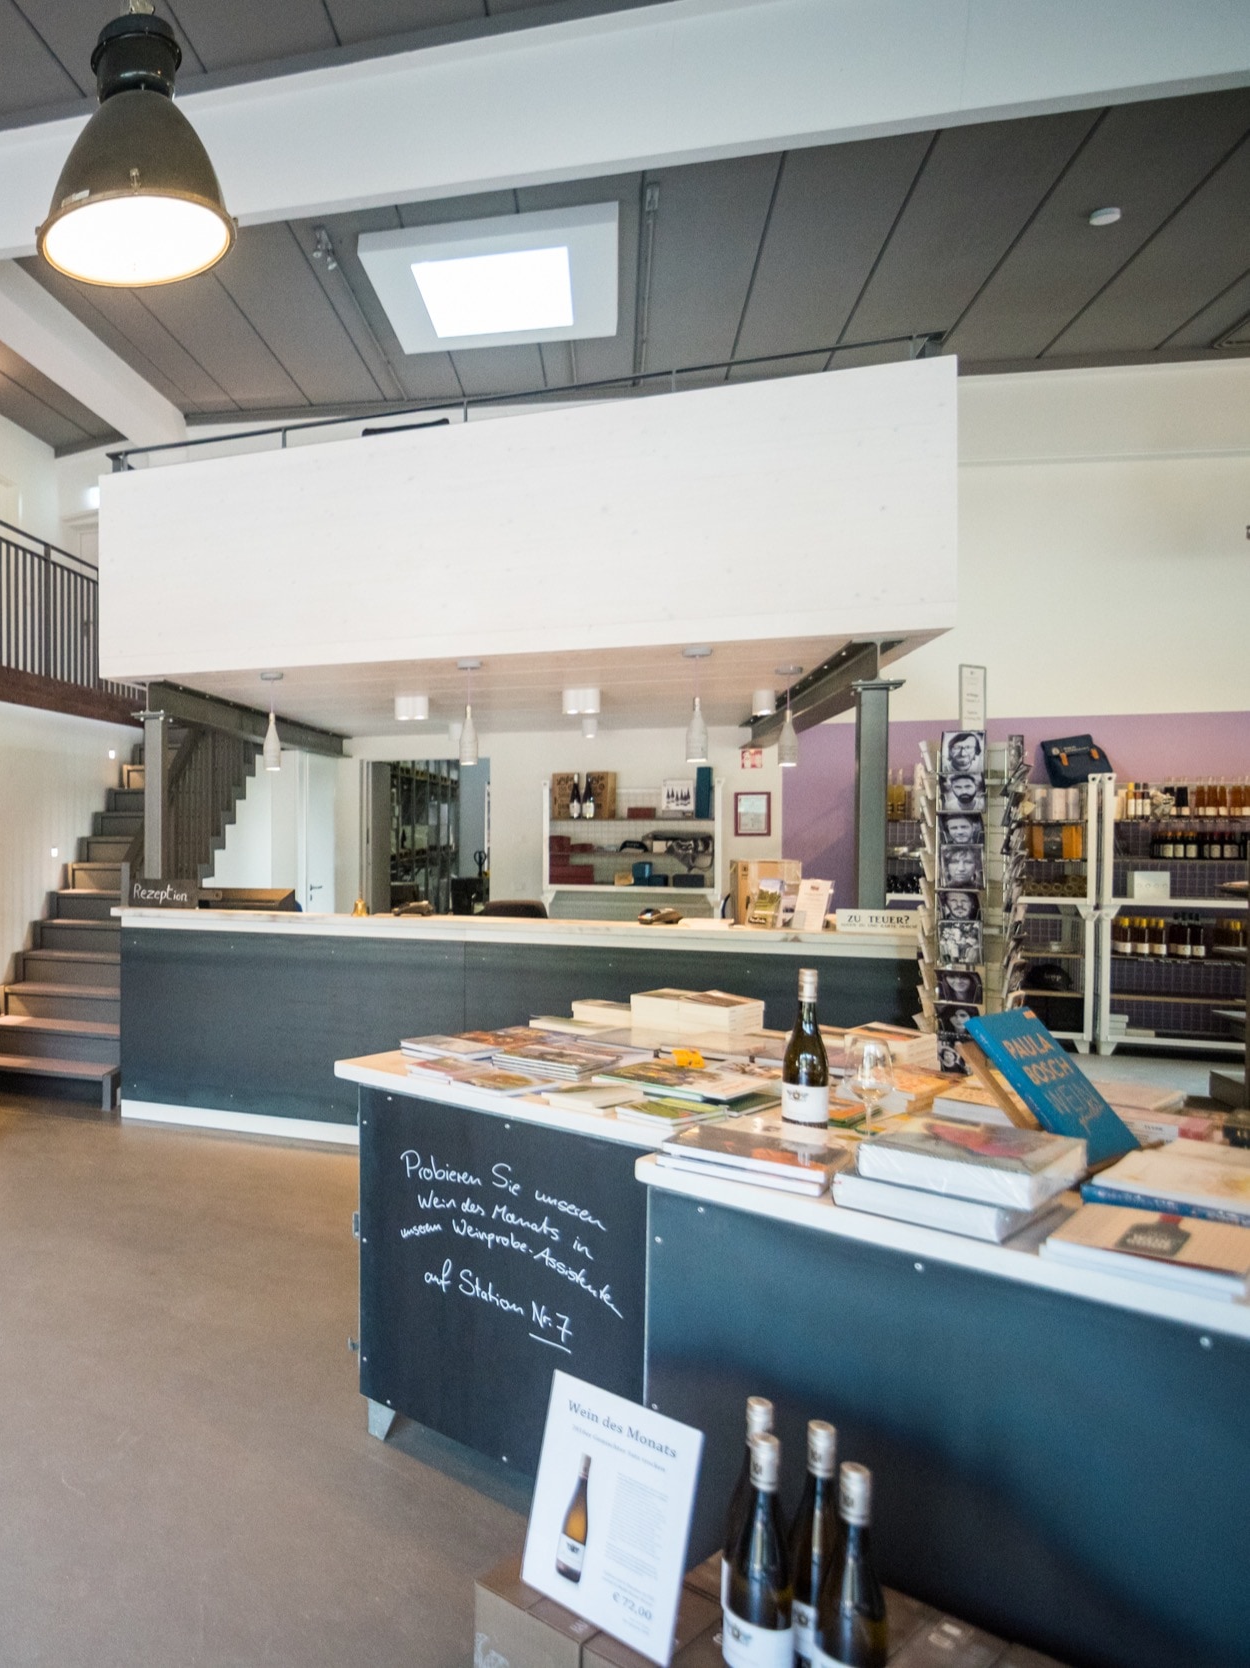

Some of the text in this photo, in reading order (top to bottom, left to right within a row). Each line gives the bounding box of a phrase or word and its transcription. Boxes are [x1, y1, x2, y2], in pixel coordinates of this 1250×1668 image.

[133, 882, 188, 905] Rezeption
[847, 914, 910, 924] ZU TEUER?
[1002, 1032, 1055, 1060] PAULA
[1022, 1056, 1075, 1086] BOSCH
[400, 1149, 608, 1232] Probieren Sie unseren
[417, 1189, 594, 1261] Wein des Monats in
[424, 1257, 452, 1294] auf
[458, 1268, 525, 1316] Station
[568, 1399, 678, 1459] Wein des Monats
